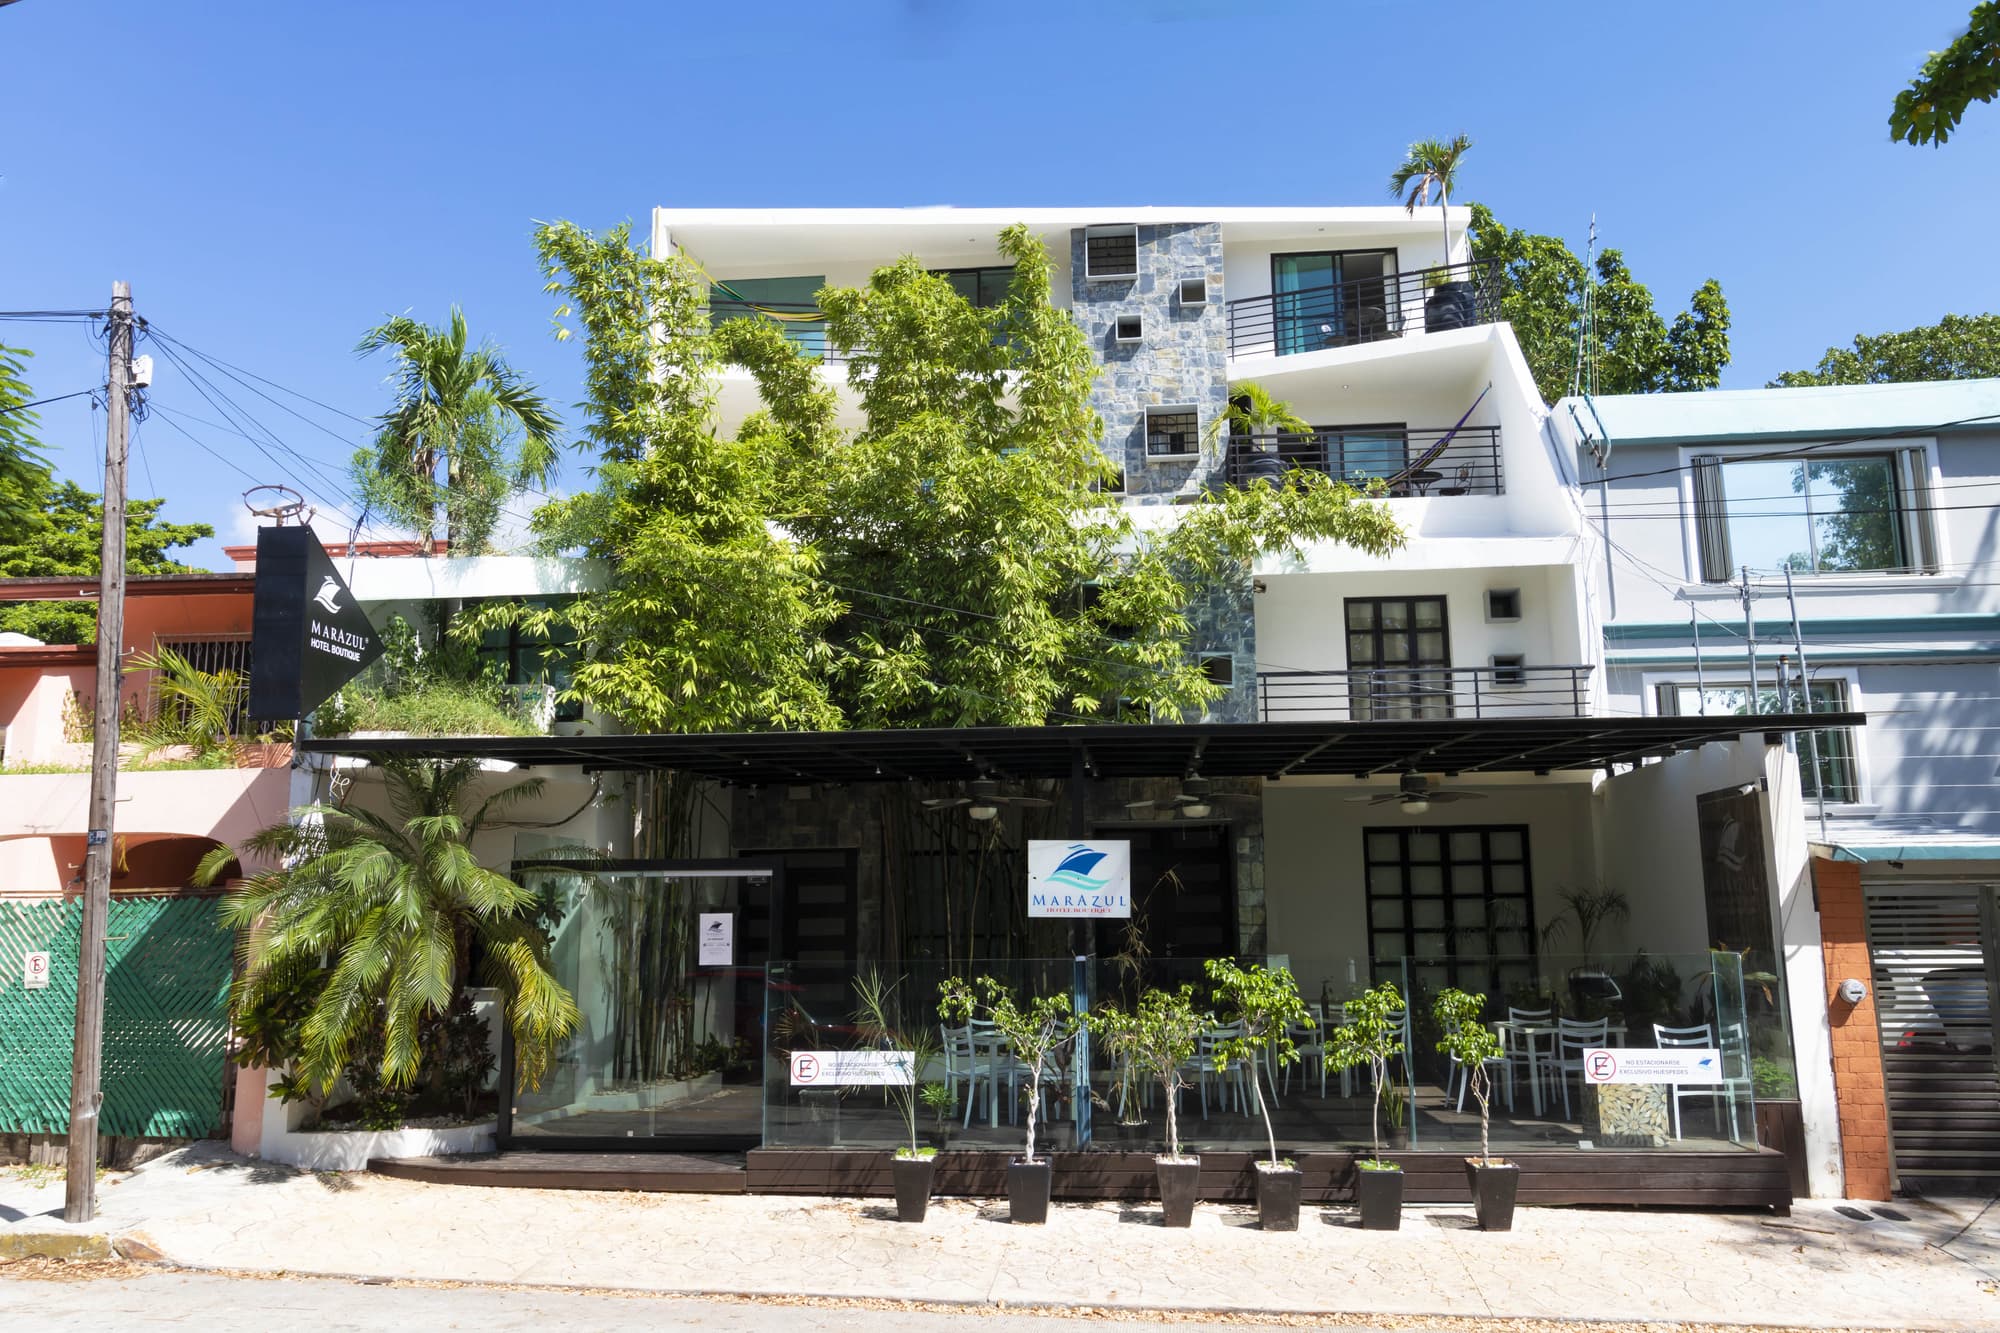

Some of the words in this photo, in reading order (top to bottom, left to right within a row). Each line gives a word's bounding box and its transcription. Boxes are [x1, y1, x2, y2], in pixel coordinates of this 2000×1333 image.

[310, 637, 331, 653] HOTEL
[331, 644, 361, 662] BOUTIQUE
[1032, 893, 1127, 908] MARAZUL
